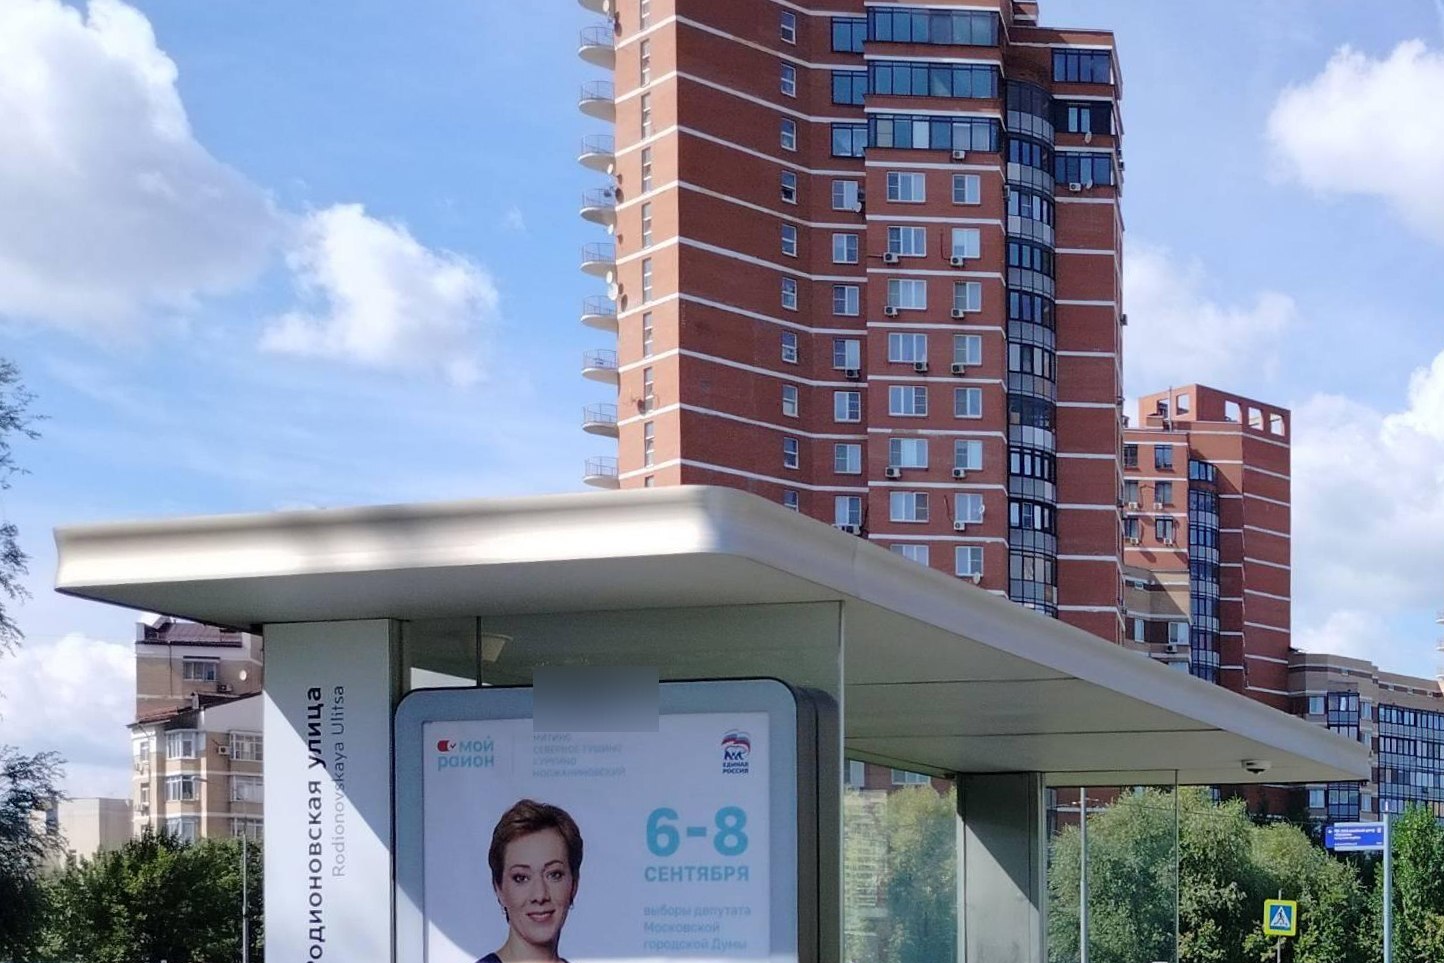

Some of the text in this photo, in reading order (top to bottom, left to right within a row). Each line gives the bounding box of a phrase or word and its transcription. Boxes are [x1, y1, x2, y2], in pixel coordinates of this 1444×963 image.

[306, 686, 327, 769] улица
[332, 685, 347, 878] Rodionovskaya Ulitsa
[645, 805, 749, 858] 6-8
[644, 865, 750, 882] СЕНТЯБРЯ
[643, 904, 692, 918] выборы
[643, 920, 720, 933] Московской
[643, 938, 709, 953] городской
